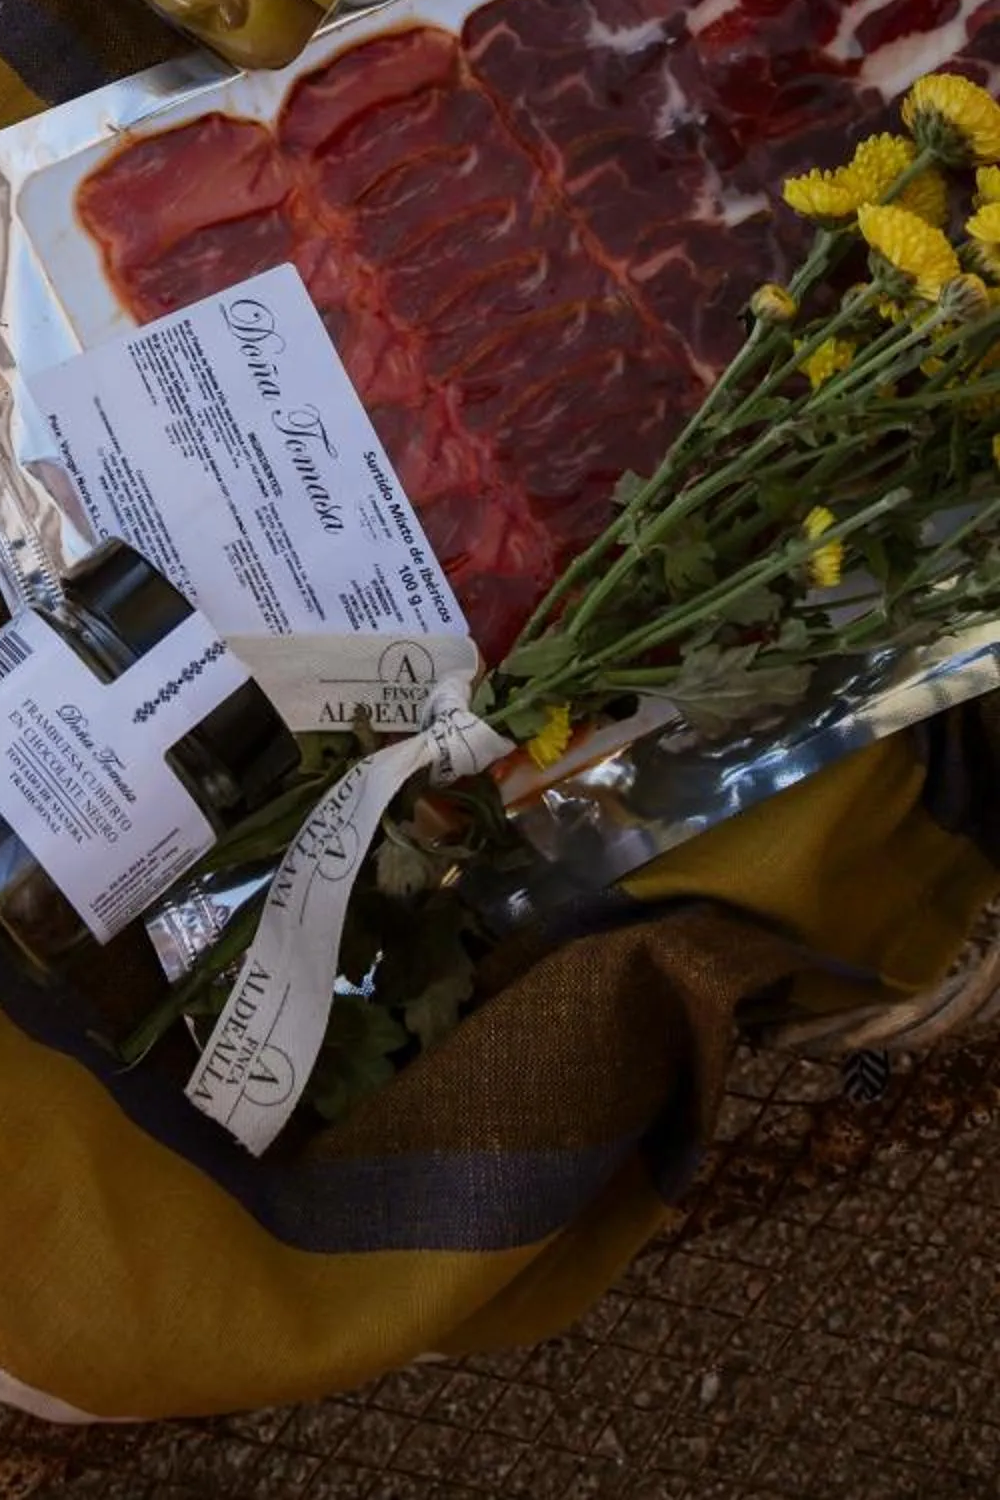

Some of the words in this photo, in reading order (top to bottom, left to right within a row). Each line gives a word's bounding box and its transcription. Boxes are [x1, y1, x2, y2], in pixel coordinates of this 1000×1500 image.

[219, 298, 285, 399] Doña
[271, 404, 345, 534] Tomasa
[362, 450, 393, 501] Surtido
[387, 503, 414, 544] Mixto
[408, 546, 424, 565] de
[419, 567, 452, 623] Ibéricos
[397, 564, 418, 592] 100
[406, 593, 422, 606] g
[394, 654, 418, 684] A
[21, 698, 83, 772] FRAMBUESA
[4, 746, 41, 789] TOSTADO
[7, 709, 26, 729] EN
[22, 727, 85, 798] CHOCOLATE
[85, 799, 118, 843] NEGRO
[91, 747, 136, 803] Tomasa
[325, 835, 347, 860] A
[226, 1036, 259, 1085] FINCA
[248, 1056, 279, 1085] A
